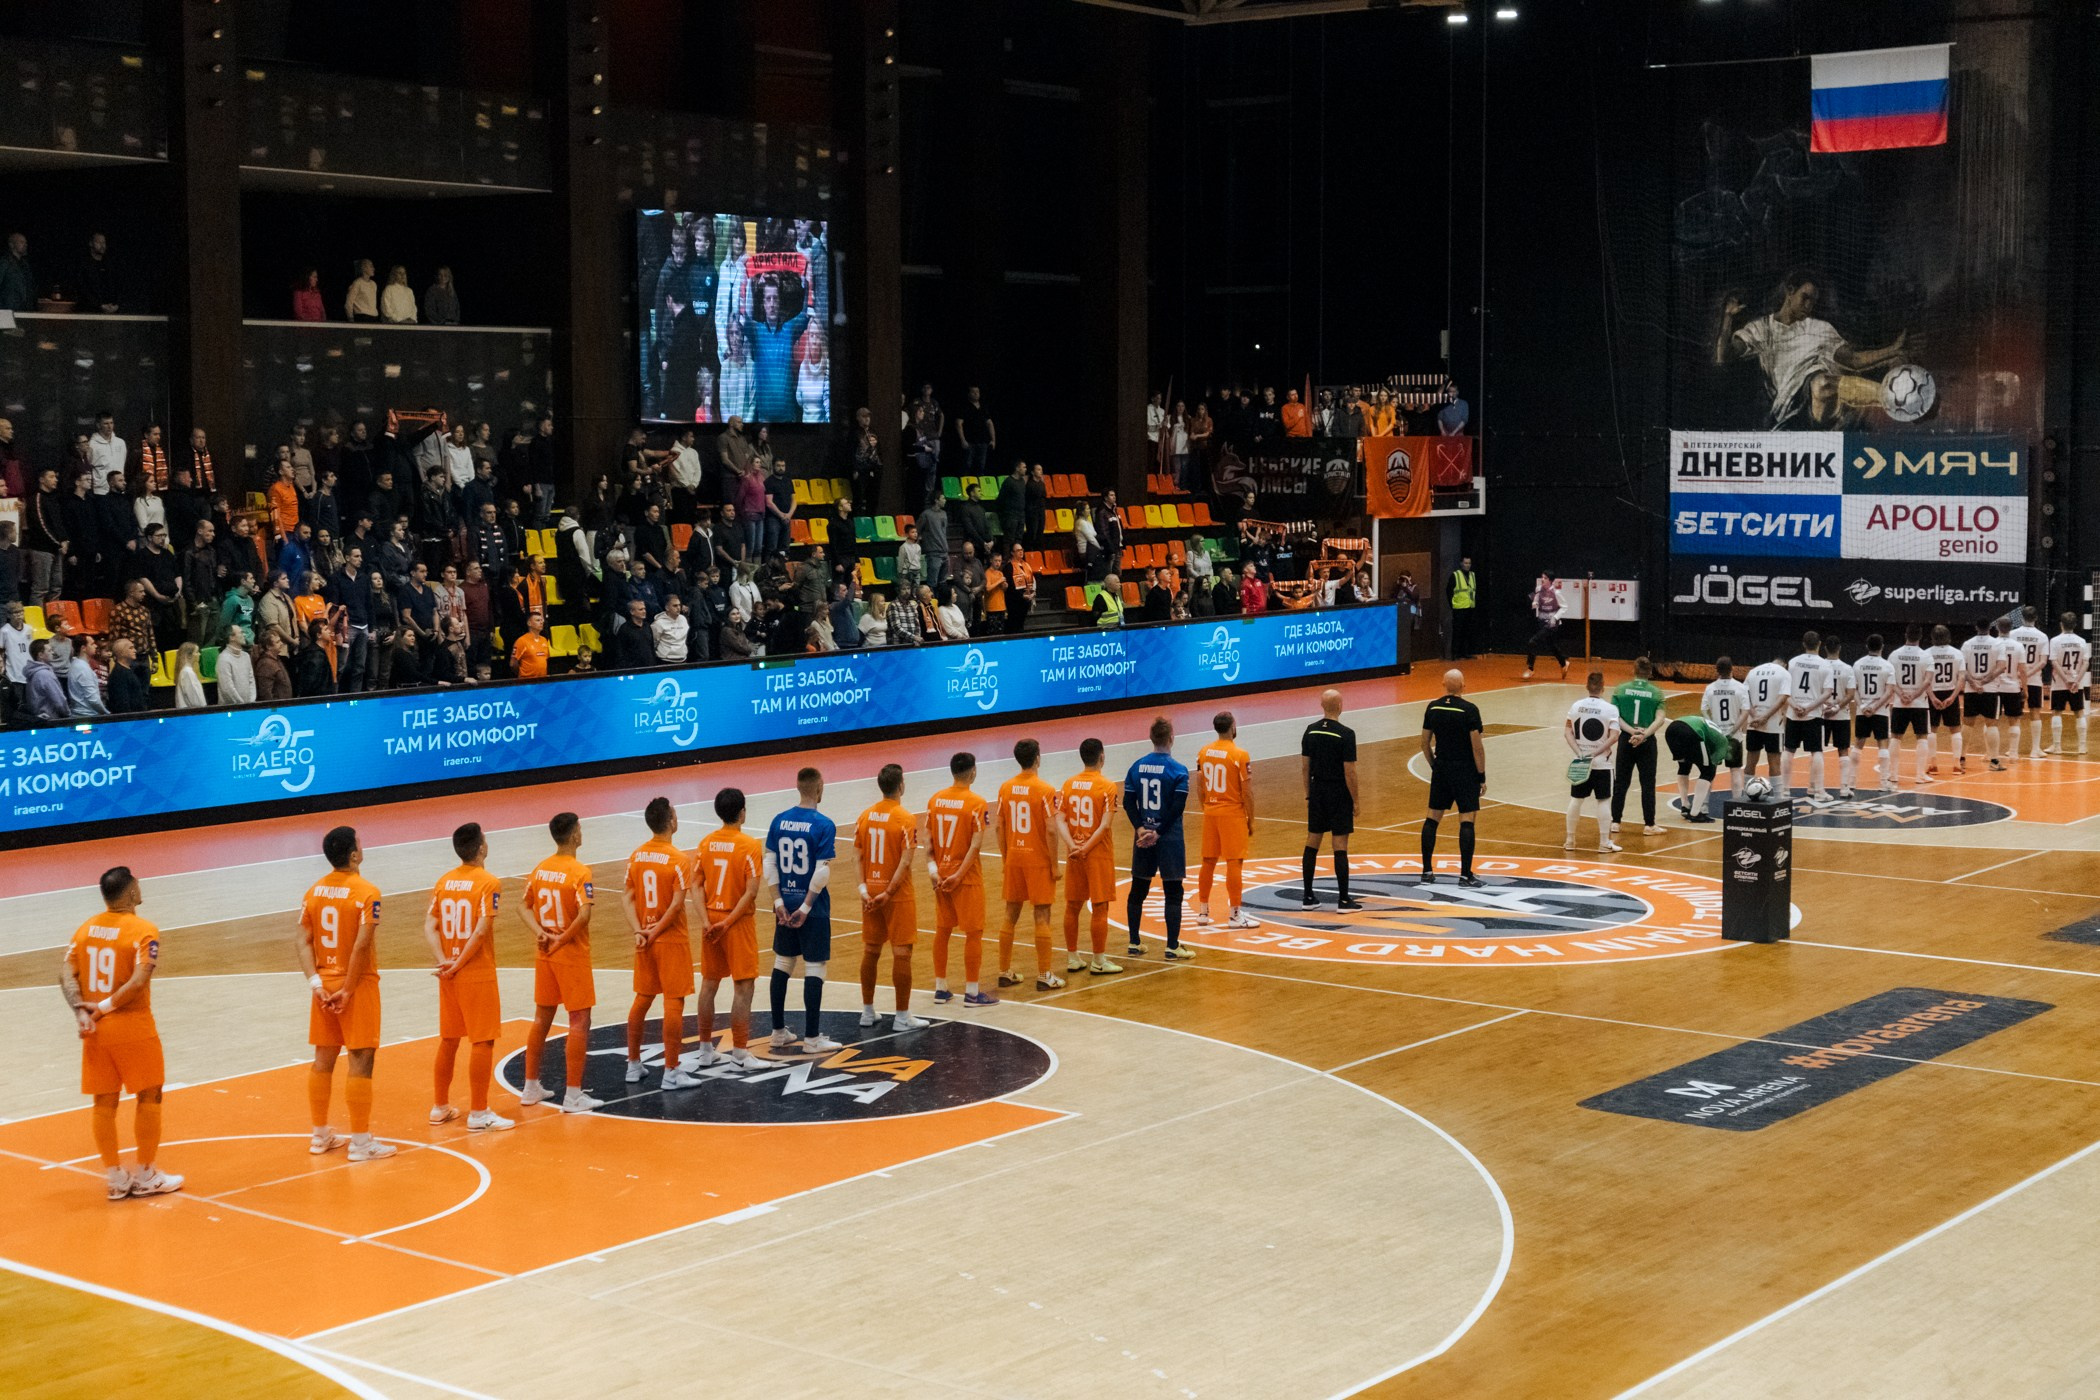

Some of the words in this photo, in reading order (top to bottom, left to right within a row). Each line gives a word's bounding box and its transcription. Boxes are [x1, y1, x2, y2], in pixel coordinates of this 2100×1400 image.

[1678, 451, 1836, 478] ДНЕВНИК
[1895, 451, 2018, 476] МЯЧ
[1261, 478, 1307, 494] ЛИСЫ
[1674, 511, 1835, 538] БЕТСИТИ
[1866, 504, 2000, 532] APOLLO
[1939, 535, 1998, 557] genio
[1674, 565, 1834, 609] JÖGEL
[1884, 583, 2020, 607] superliga.rfs.ru
[1284, 625, 1302, 638] ГДЕ
[1305, 620, 1345, 636] ЗАБОТА,
[1052, 648, 1076, 663] ГДЕ
[1078, 642, 1126, 660] ЗАБОТА,
[1199, 650, 1240, 667] IRAERO
[1275, 644, 1295, 657] ТАМ
[1297, 643, 1304, 655] И
[1306, 637, 1354, 654] КОМФОРТ
[1041, 668, 1066, 683] ТАМ
[1068, 666, 1077, 679] И
[1080, 660, 1136, 679] КОМФОРТ
[1974, 652, 1989, 674] 19
[2062, 651, 2080, 670] 47
[766, 674, 794, 691] ГДЕ
[798, 668, 858, 687] ЗАБОТА,
[947, 674, 998, 694] IRAERO
[1799, 671, 1810, 694] 4
[1863, 673, 1877, 695] 15
[1901, 663, 1917, 685] 21
[1935, 662, 1953, 684] 29
[1077, 684, 1102, 693] iraero.ru
[1758, 679, 1768, 702] 9
[751, 698, 782, 715] ТАМ
[786, 696, 797, 711] И
[800, 688, 872, 710] КОМФОРТ
[1633, 699, 1641, 725] 1
[1720, 698, 1730, 722] 8
[402, 707, 438, 730] ГДЕ
[443, 701, 520, 723] ЗАБОТА,
[634, 707, 698, 727] IRAERO
[797, 715, 828, 726] iraero.ru
[384, 736, 423, 755] ТАМ
[428, 734, 441, 750] И
[446, 723, 538, 748] КОМФОРТ
[12, 741, 113, 766] ЗАБОТА,
[232, 747, 314, 771] IRAERO
[443, 755, 482, 766] iraero.ru
[18, 765, 137, 795] КОМФОРТ
[1202, 762, 1227, 794] 90
[1140, 778, 1162, 811] 13
[14, 801, 63, 816] iraero.ru
[1009, 801, 1031, 834] 18
[1069, 795, 1094, 828] 39
[1728, 807, 1766, 819] JÖGEL
[1772, 808, 1791, 819] JÖGEL
[936, 814, 958, 848] 17
[778, 837, 809, 875] 83
[868, 828, 886, 865] 11
[714, 859, 729, 896] 7
[1533, 864, 1619, 879] BE
[643, 870, 659, 909] 8
[440, 898, 472, 940] 80
[538, 888, 565, 928] 21
[320, 906, 338, 948] 9
[1235, 932, 1334, 950] BE
[1346, 943, 1565, 957] HARD
[86, 946, 116, 993] 19
[1782, 998, 1987, 1069] #novaarena
[1685, 1098, 1749, 1119] NOVA
[1738, 1076, 1806, 1100] ARENA
